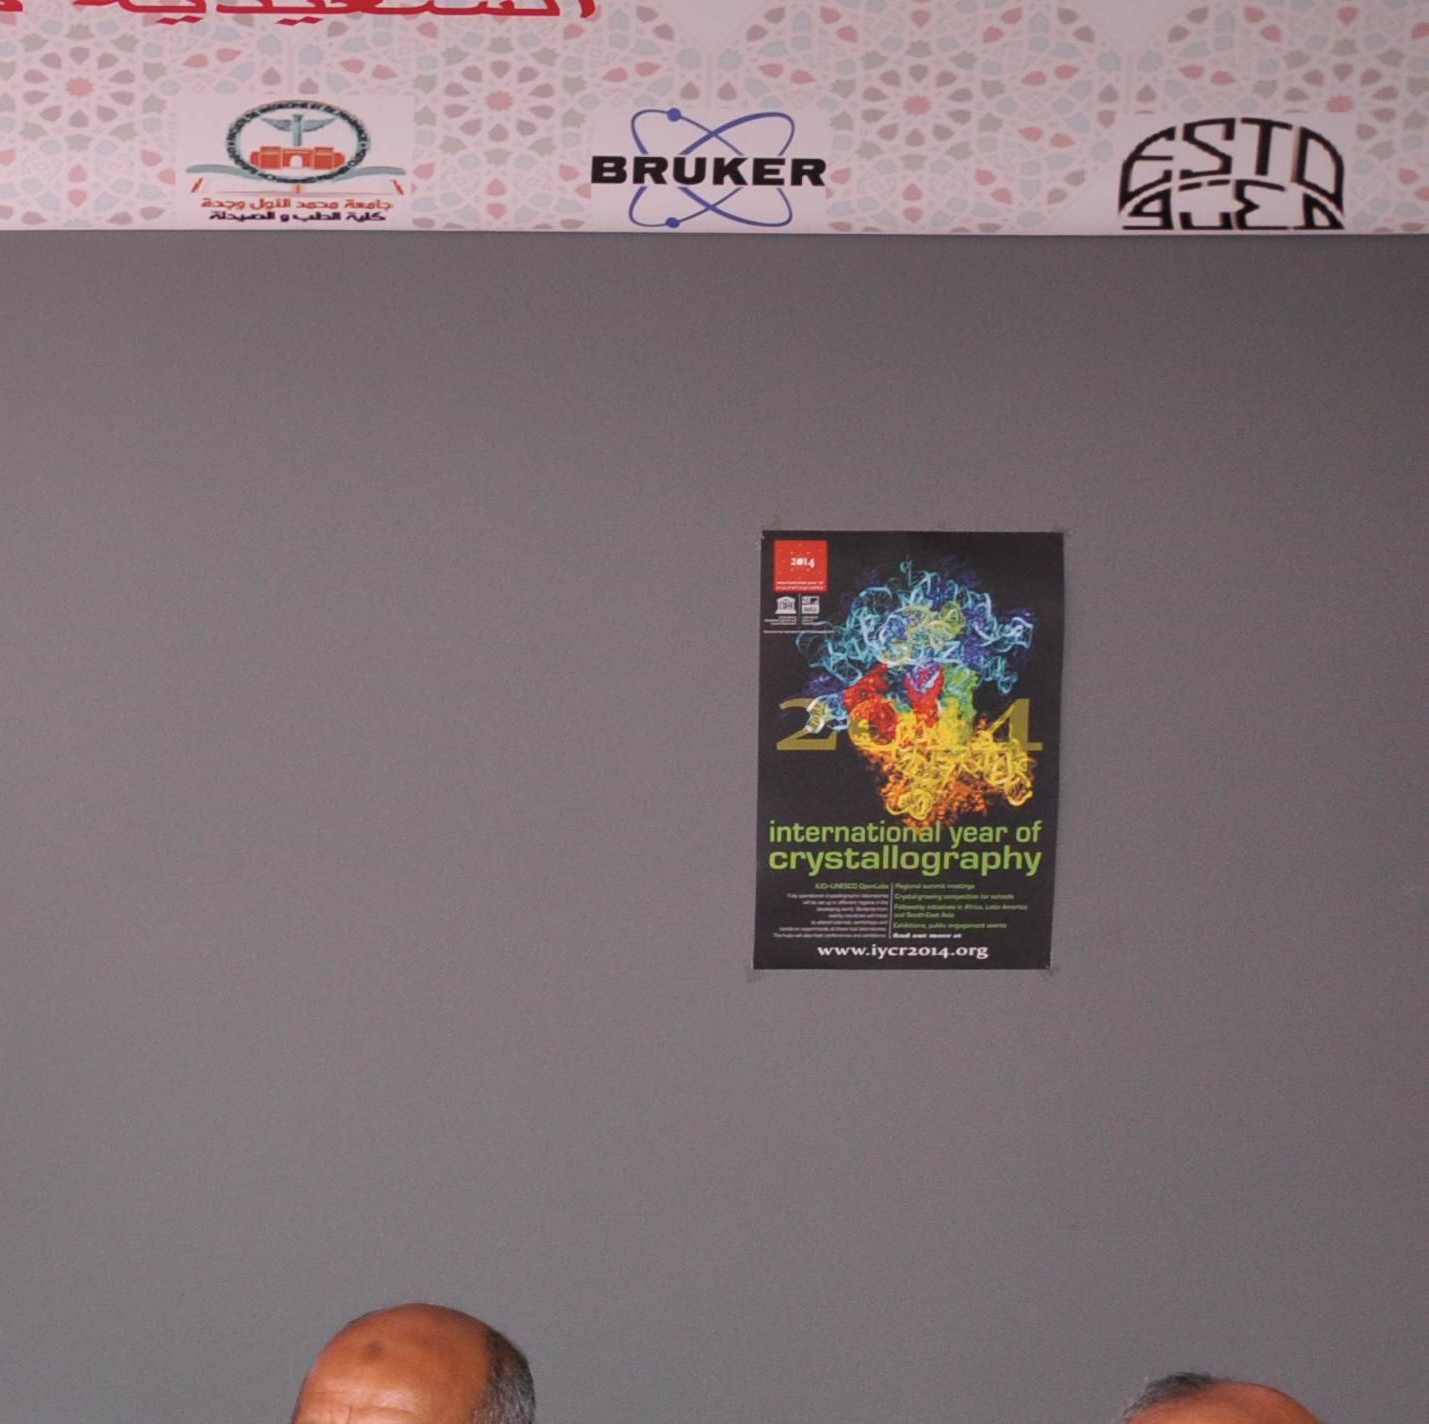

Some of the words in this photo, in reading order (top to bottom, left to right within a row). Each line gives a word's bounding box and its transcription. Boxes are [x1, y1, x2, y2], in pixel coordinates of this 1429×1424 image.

[591, 154, 826, 188] BRUKER
[769, 820, 941, 843] international
[949, 823, 1008, 848] year
[1015, 820, 1043, 843] of
[768, 844, 1042, 877] crystallography
[817, 944, 990, 960] www.iycr2014.org
